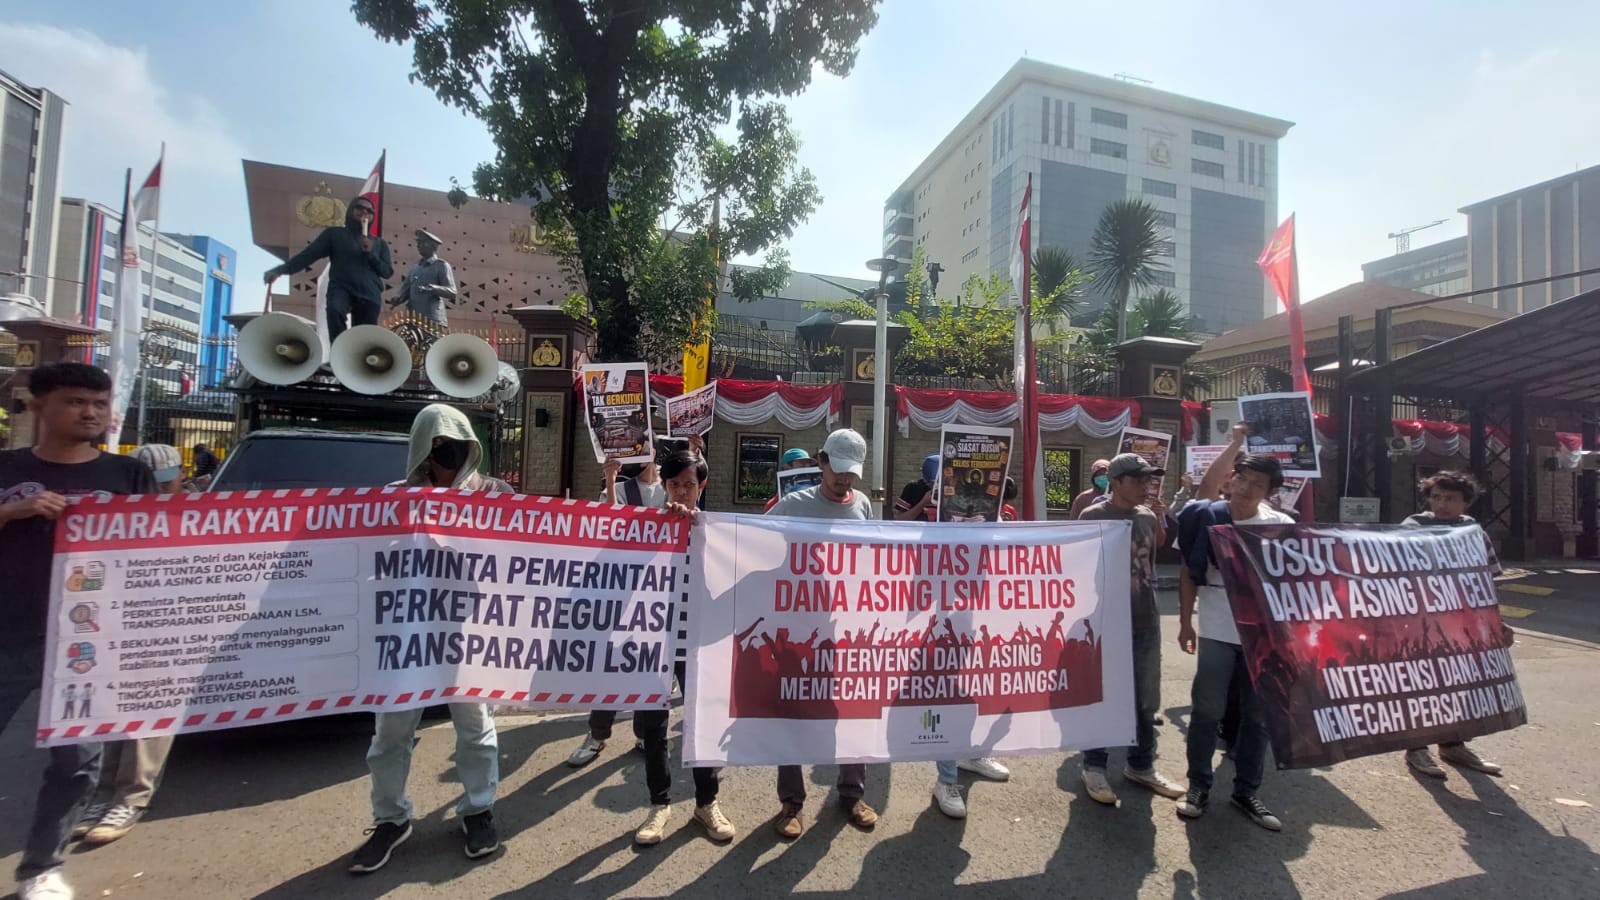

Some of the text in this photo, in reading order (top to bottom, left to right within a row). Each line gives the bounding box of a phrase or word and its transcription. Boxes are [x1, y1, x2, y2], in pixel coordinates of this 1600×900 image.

[591, 392, 644, 406] TAK BERKUTIK!
[958, 442, 979, 452] SIASAT
[66, 500, 680, 544] SUARA RAKYAT UNTUK KEDAULATAN NEGARA!
[126, 559, 312, 579] USUT TUNTAS DUGAAN ALIRAN
[127, 556, 189, 568] Mendesak
[193, 554, 220, 564] Polri
[223, 553, 245, 562] dan
[248, 550, 309, 562] Kejaksaan:
[790, 542, 1064, 576] USUT TUNTAS ALIRAN
[1261, 538, 1340, 577] USUT
[1342, 535, 1433, 574] TUNTAS
[124, 579, 162, 590] DANA
[164, 577, 202, 588] ASING
[206, 575, 222, 584] KE
[225, 572, 252, 582] NGO
[262, 570, 308, 580] CELIOS.
[375, 548, 677, 592] MEMINTA PEMERINTAH
[111, 592, 246, 610] 2. Meminta Pemerintah
[774, 578, 1075, 612] DANA ASING LSM CELIOS
[1262, 571, 1498, 622] DANA ASING LSM CELI
[122, 602, 246, 619] PERKETAT REGULASI
[122, 608, 322, 630] TRANSPARANSI PENDANAAN LSM.
[375, 588, 675, 632] PERKETAT REGULASI
[120, 636, 331, 661] pendanaan asing untuk mengganggu
[121, 637, 179, 649] BEKUKAN
[183, 634, 208, 644] LSM
[212, 632, 239, 645] yang
[242, 622, 344, 641] menyalahgunakan
[119, 653, 241, 672] stabilitas Kamtibmas.
[375, 631, 668, 673] TRANSPARANSI LSM.
[814, 644, 1042, 673] INTERVENSI DANA ASING
[106, 671, 244, 690] 4. Mengajak masyarakat
[118, 676, 295, 701] TINGKATKAN KEWASPADAAN
[780, 668, 1069, 701] MEMECAH PERSATUAN BANGSA
[1322, 658, 1439, 700] INTERVENSI
[1437, 653, 1482, 687] DANA
[116, 686, 300, 712] TERHADAP INTERVENSI ASING.
[1312, 700, 1407, 743] MEMECAH
[1406, 686, 1500, 729] PERSATUAN
